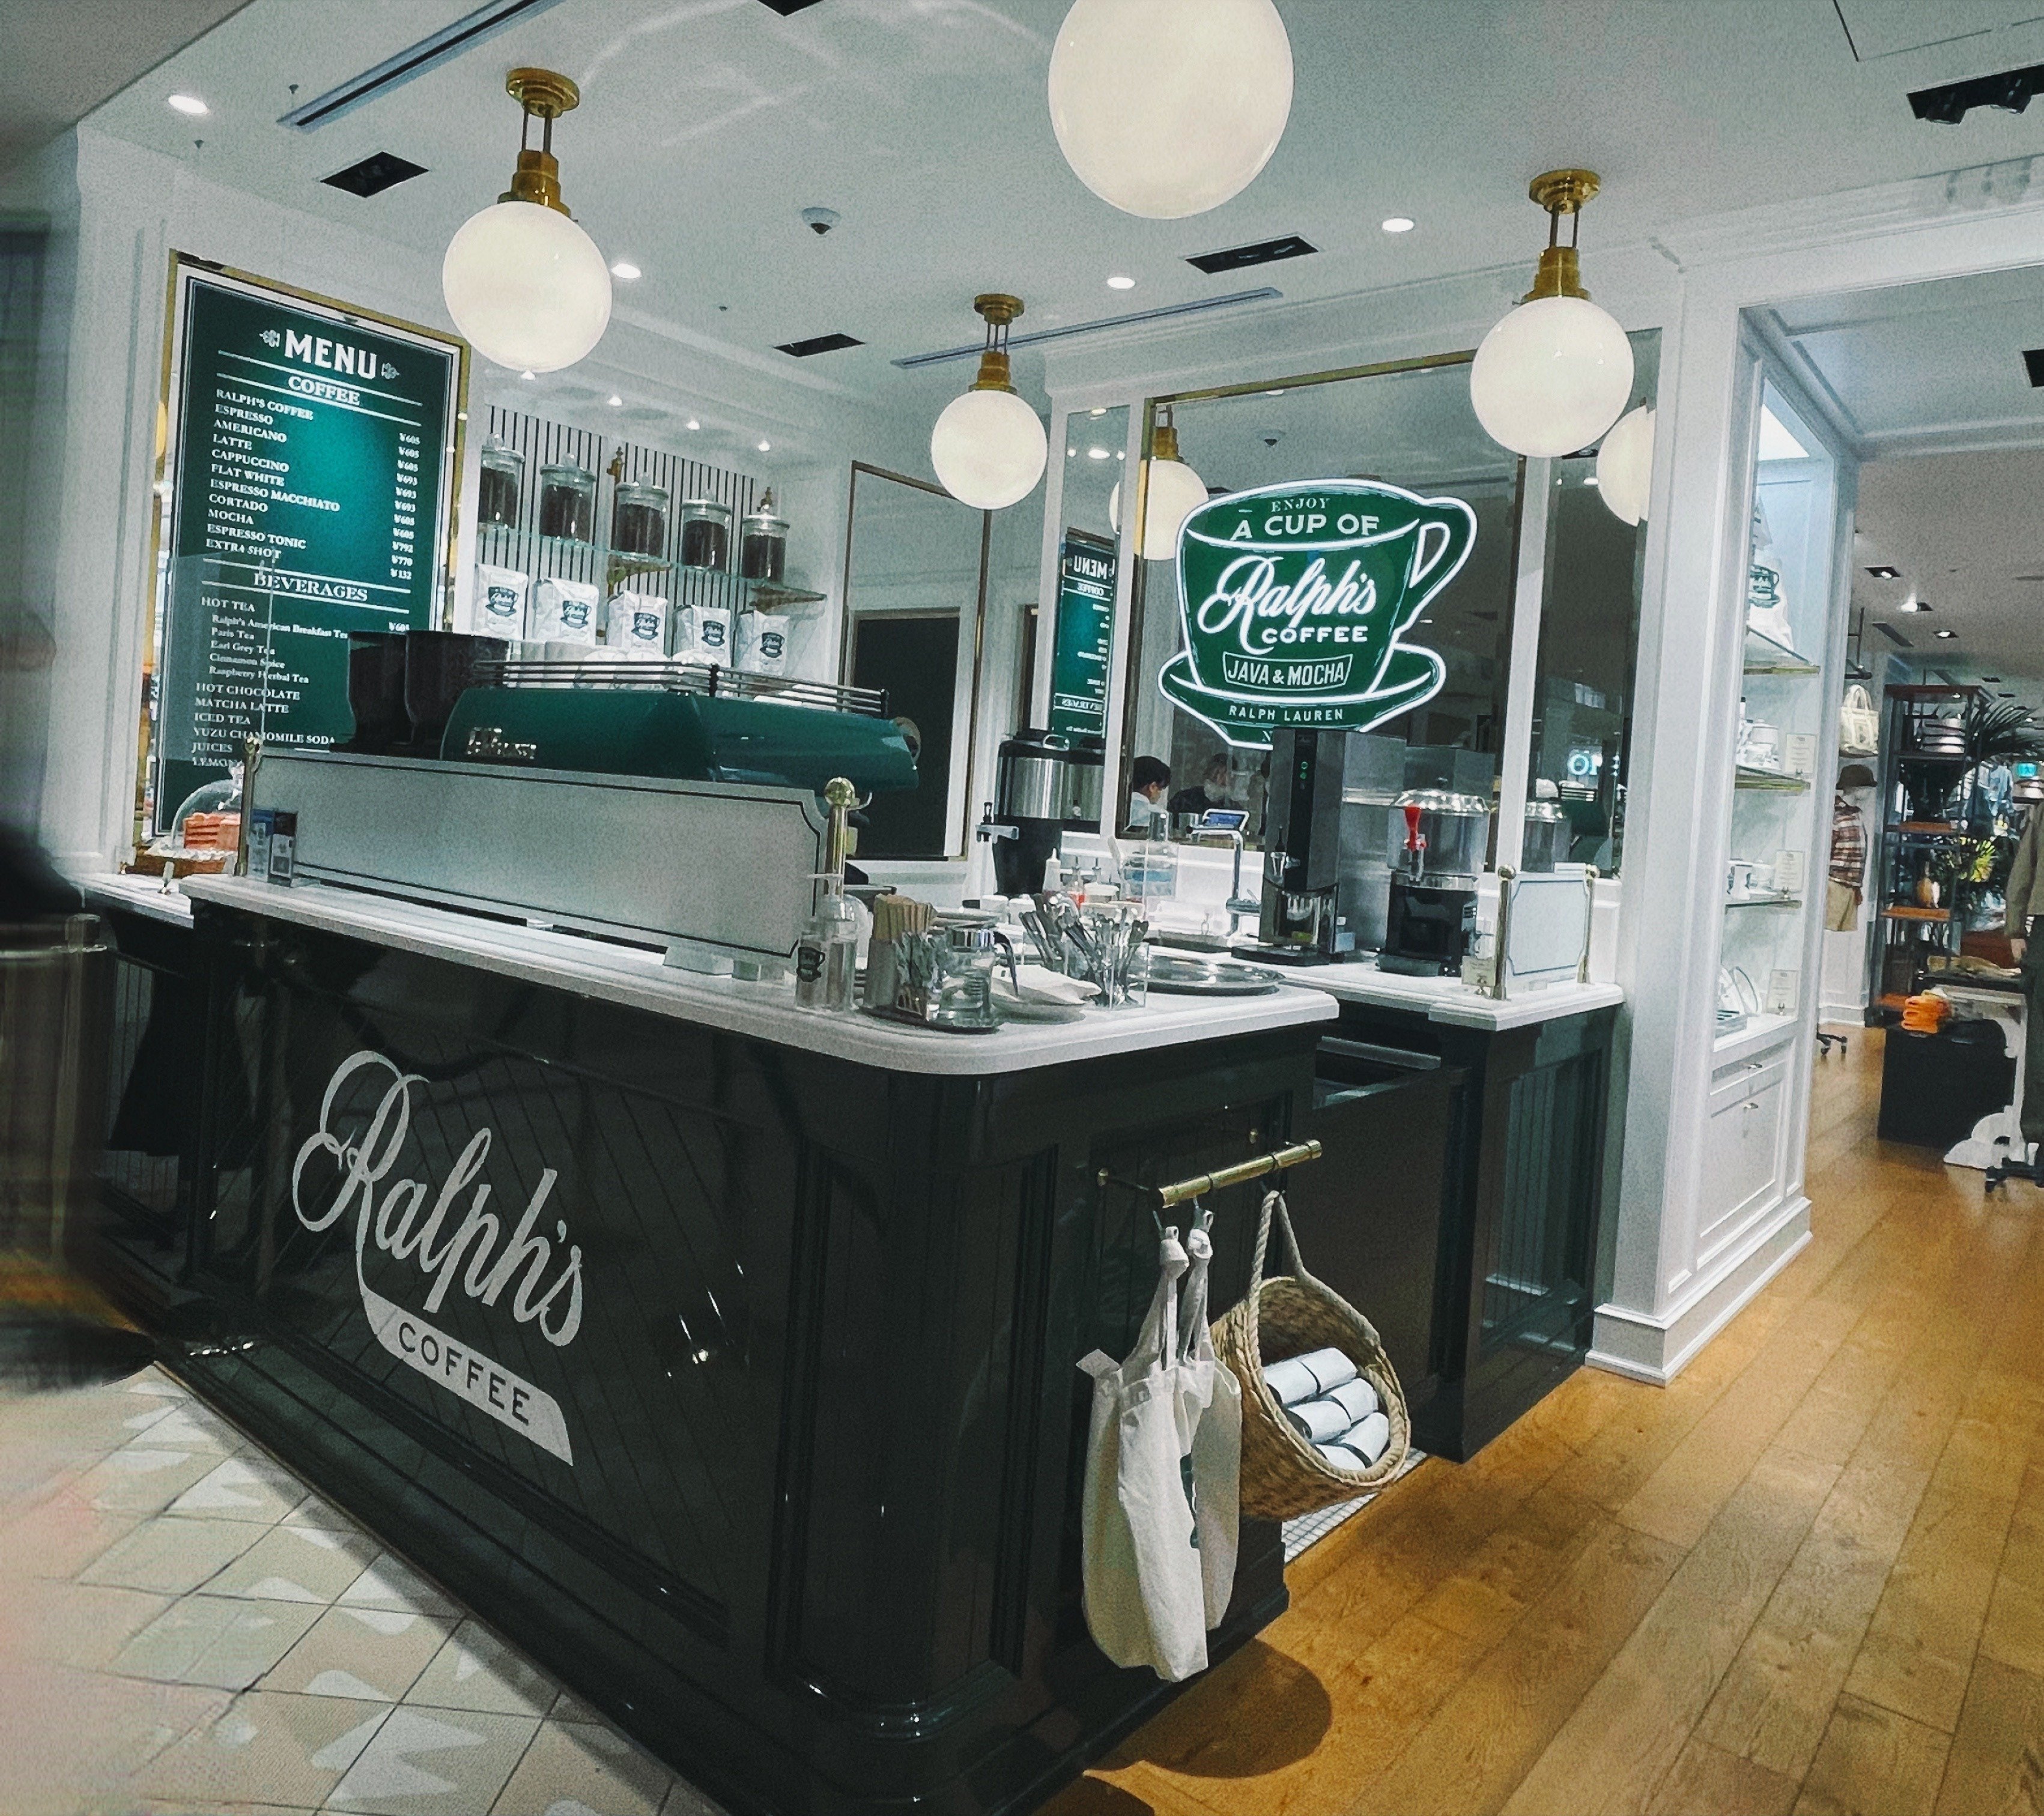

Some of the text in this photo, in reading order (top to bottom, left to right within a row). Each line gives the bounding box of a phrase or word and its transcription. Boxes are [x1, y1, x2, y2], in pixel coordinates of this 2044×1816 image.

[284, 328, 378, 380] MENU
[288, 375, 360, 406] COFFEE
[214, 404, 274, 425] ESPRESSO
[216, 389, 314, 420] RALPH'S COFFEE
[213, 419, 287, 443] AMERICANO
[213, 434, 252, 450] LATTE
[211, 449, 290, 473] CAPPUCCINO
[211, 464, 285, 487] FLAT WHITE
[209, 494, 268, 513] CORTADO
[210, 478, 341, 512] ESPRESSO MACCHIATO
[1272, 497, 1330, 513] ENJOY
[208, 509, 254, 525] MOCHA
[1230, 513, 1380, 540] A CUP OF
[207, 523, 306, 549] ESPRESSO TONIC
[206, 538, 282, 559] EXTRA SHOT
[253, 572, 368, 602] BEVERAGES
[201, 596, 255, 612] HOT TEA
[1198, 555, 1378, 655] Ralph's
[236, 629, 254, 640] Tea
[1261, 626, 1369, 644] COFFEE
[291, 674, 309, 683] Tea
[1227, 660, 1345, 686] JAVA & MOCHA
[196, 682, 300, 700] HOT CHOCOLATE
[194, 698, 290, 713] MATCHA LATTE
[1229, 705, 1344, 721] RALPH LAUREN
[195, 712, 250, 725] ICED TEA
[193, 727, 227, 738] YUZU
[306, 735, 335, 745] SODA
[191, 742, 232, 754] JUICES
[293, 1050, 583, 1346] Ralph's
[398, 1322, 530, 1426] COFFEE
